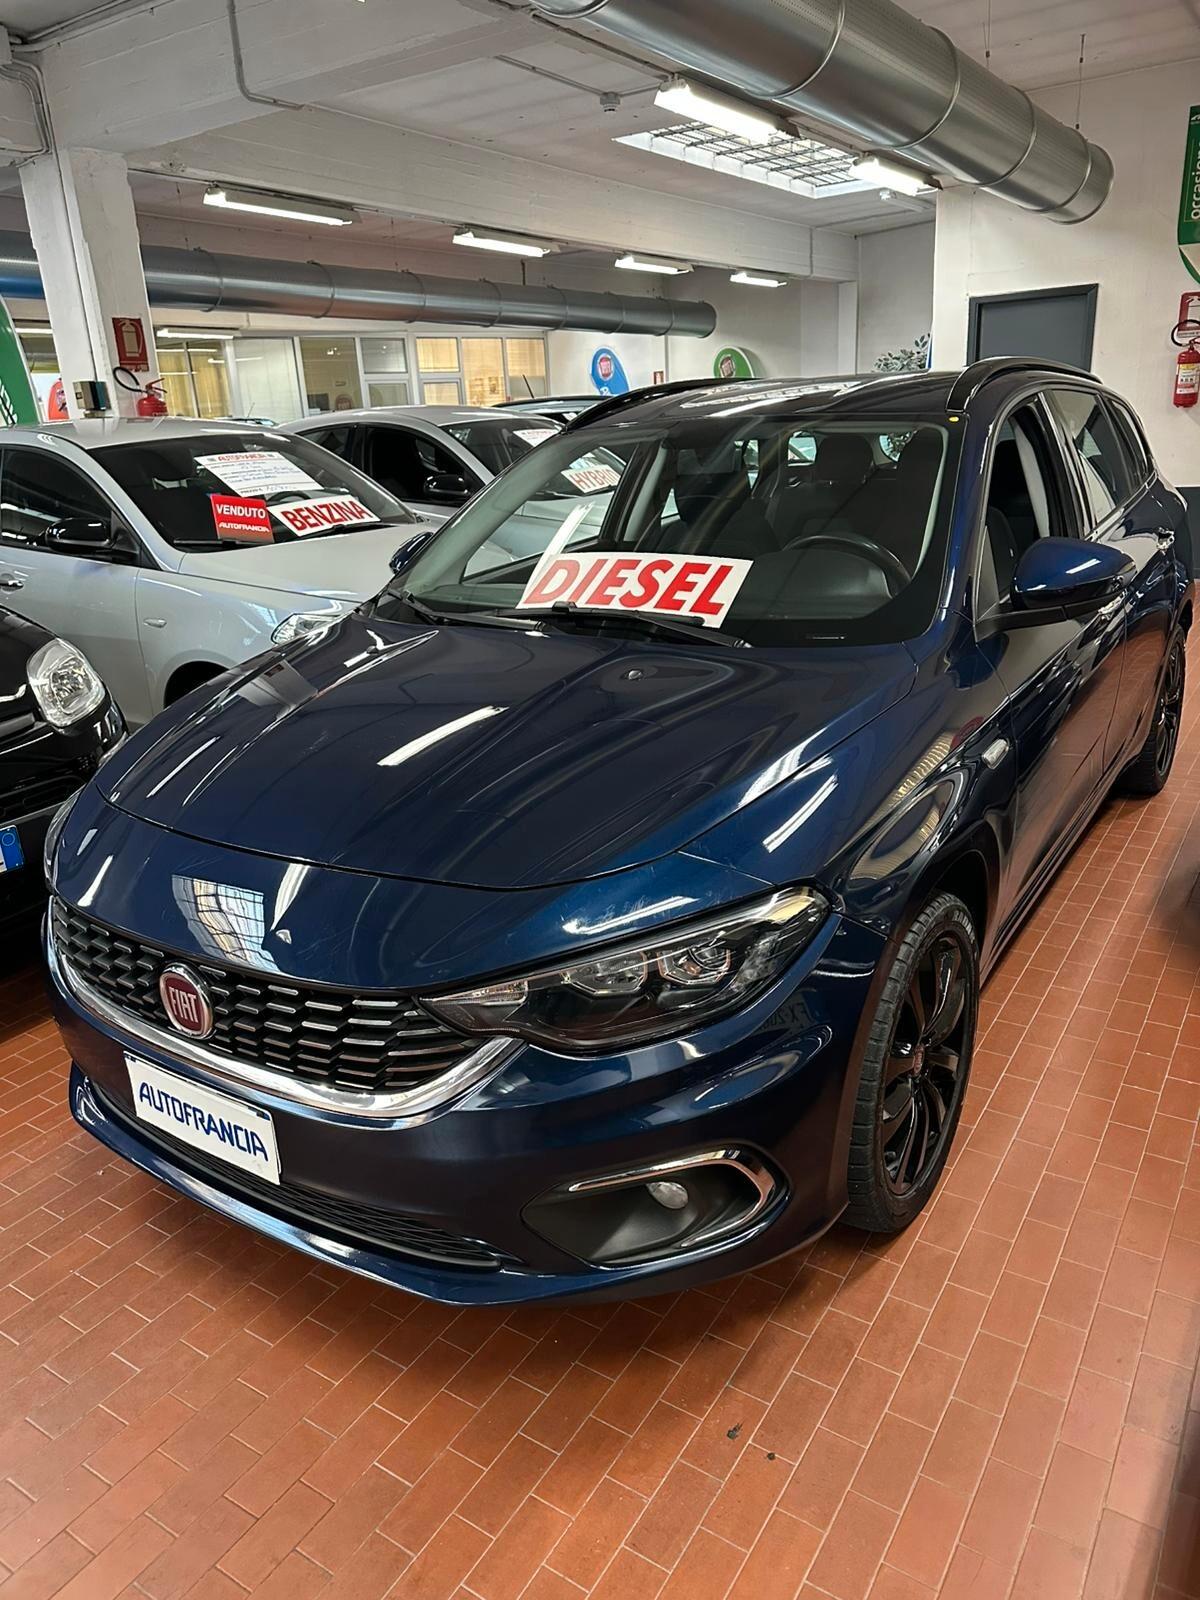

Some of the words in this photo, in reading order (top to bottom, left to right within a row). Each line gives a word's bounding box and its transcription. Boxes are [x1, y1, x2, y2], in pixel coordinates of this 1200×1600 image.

[569, 468, 617, 490] HYBRID
[216, 503, 266, 519] VENDUTO
[281, 500, 373, 531] BENZINA
[218, 521, 270, 533] AUTOFRANCIA
[523, 558, 733, 616] DIESEL
[169, 987, 199, 1022] FIAT
[139, 1081, 269, 1162] AUTOFRANCIA
